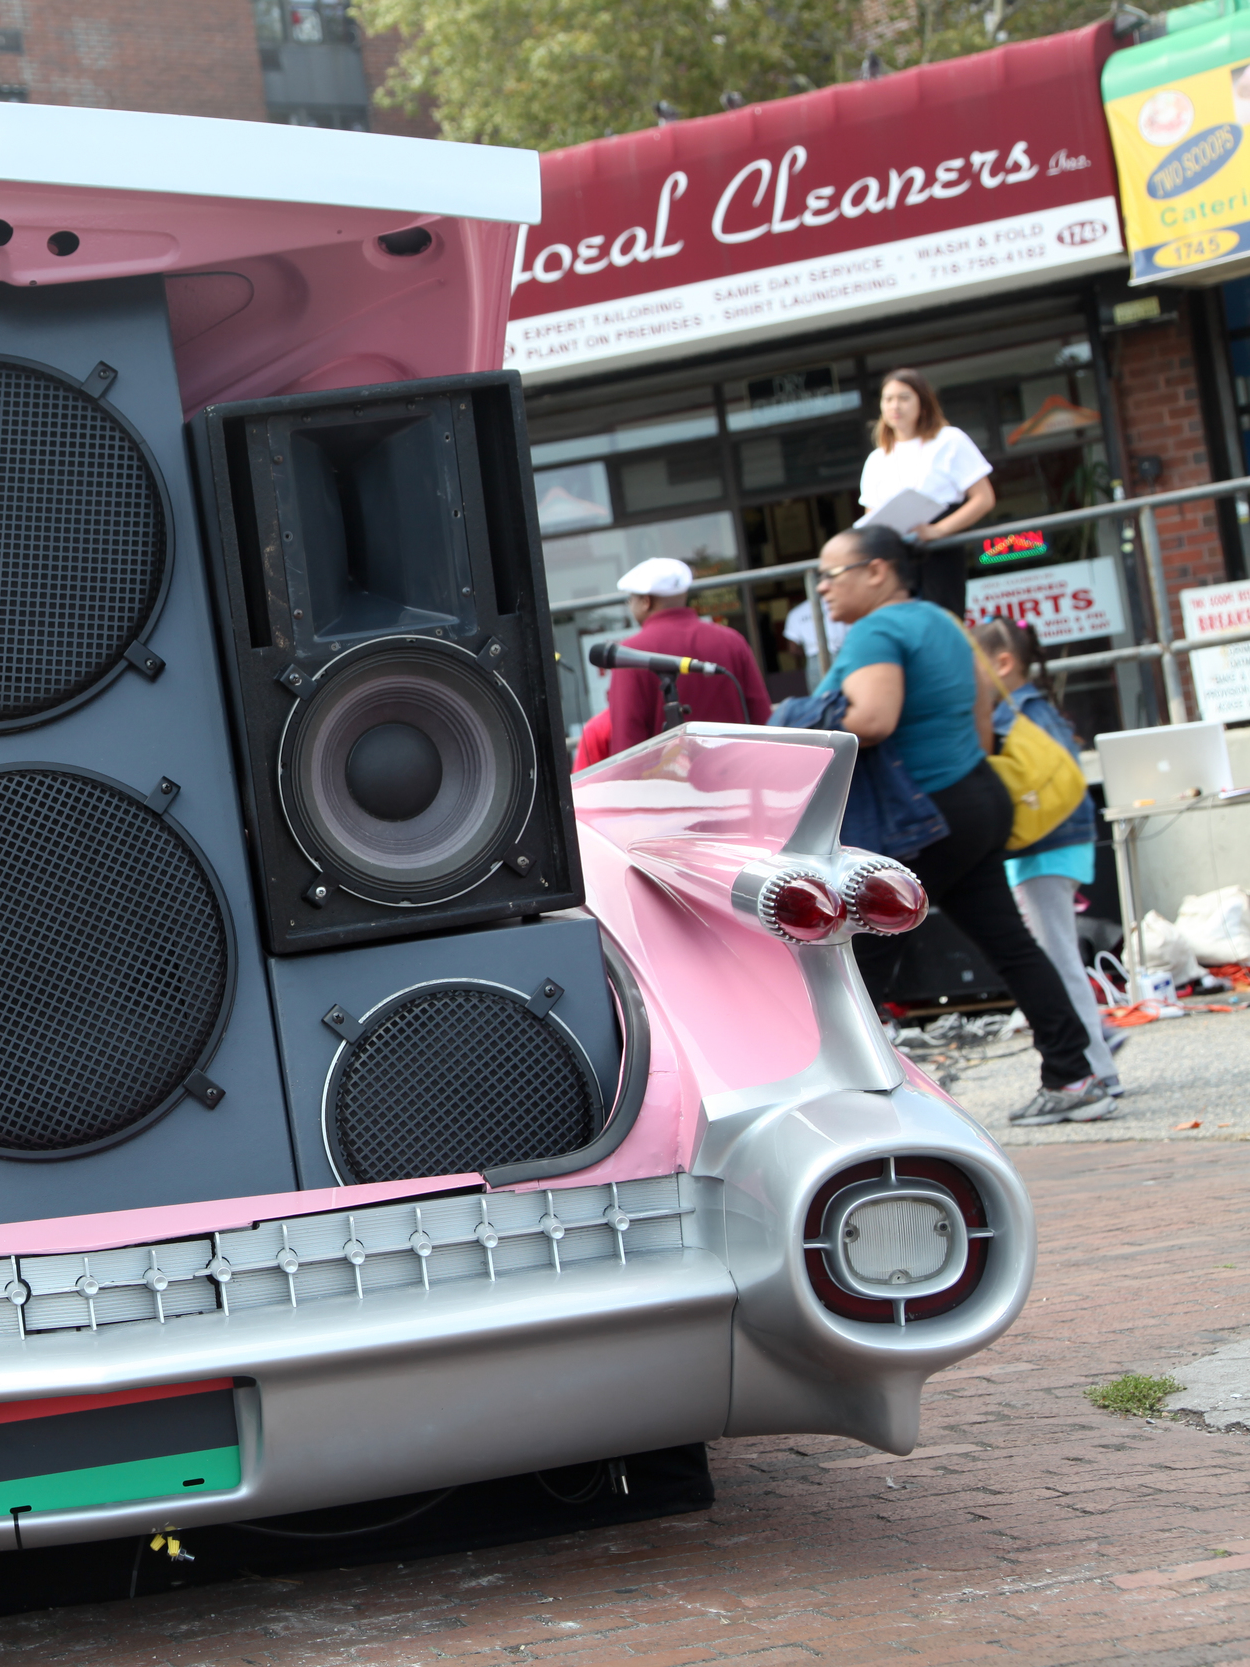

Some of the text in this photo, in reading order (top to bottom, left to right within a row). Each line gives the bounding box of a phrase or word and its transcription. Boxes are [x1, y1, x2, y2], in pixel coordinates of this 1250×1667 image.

[712, 141, 1038, 243] Cleaners
[1153, 124, 1234, 197] TWO SCOOPS
[1060, 221, 1107, 245] 1743
[1175, 237, 1220, 261] 1745
[523, 317, 586, 341] EXPERT
[714, 278, 762, 302] SAME
[768, 272, 801, 291] DAY
[809, 255, 884, 282] SERVICE
[916, 241, 970, 260] WASH
[995, 222, 1044, 243] FOLD
